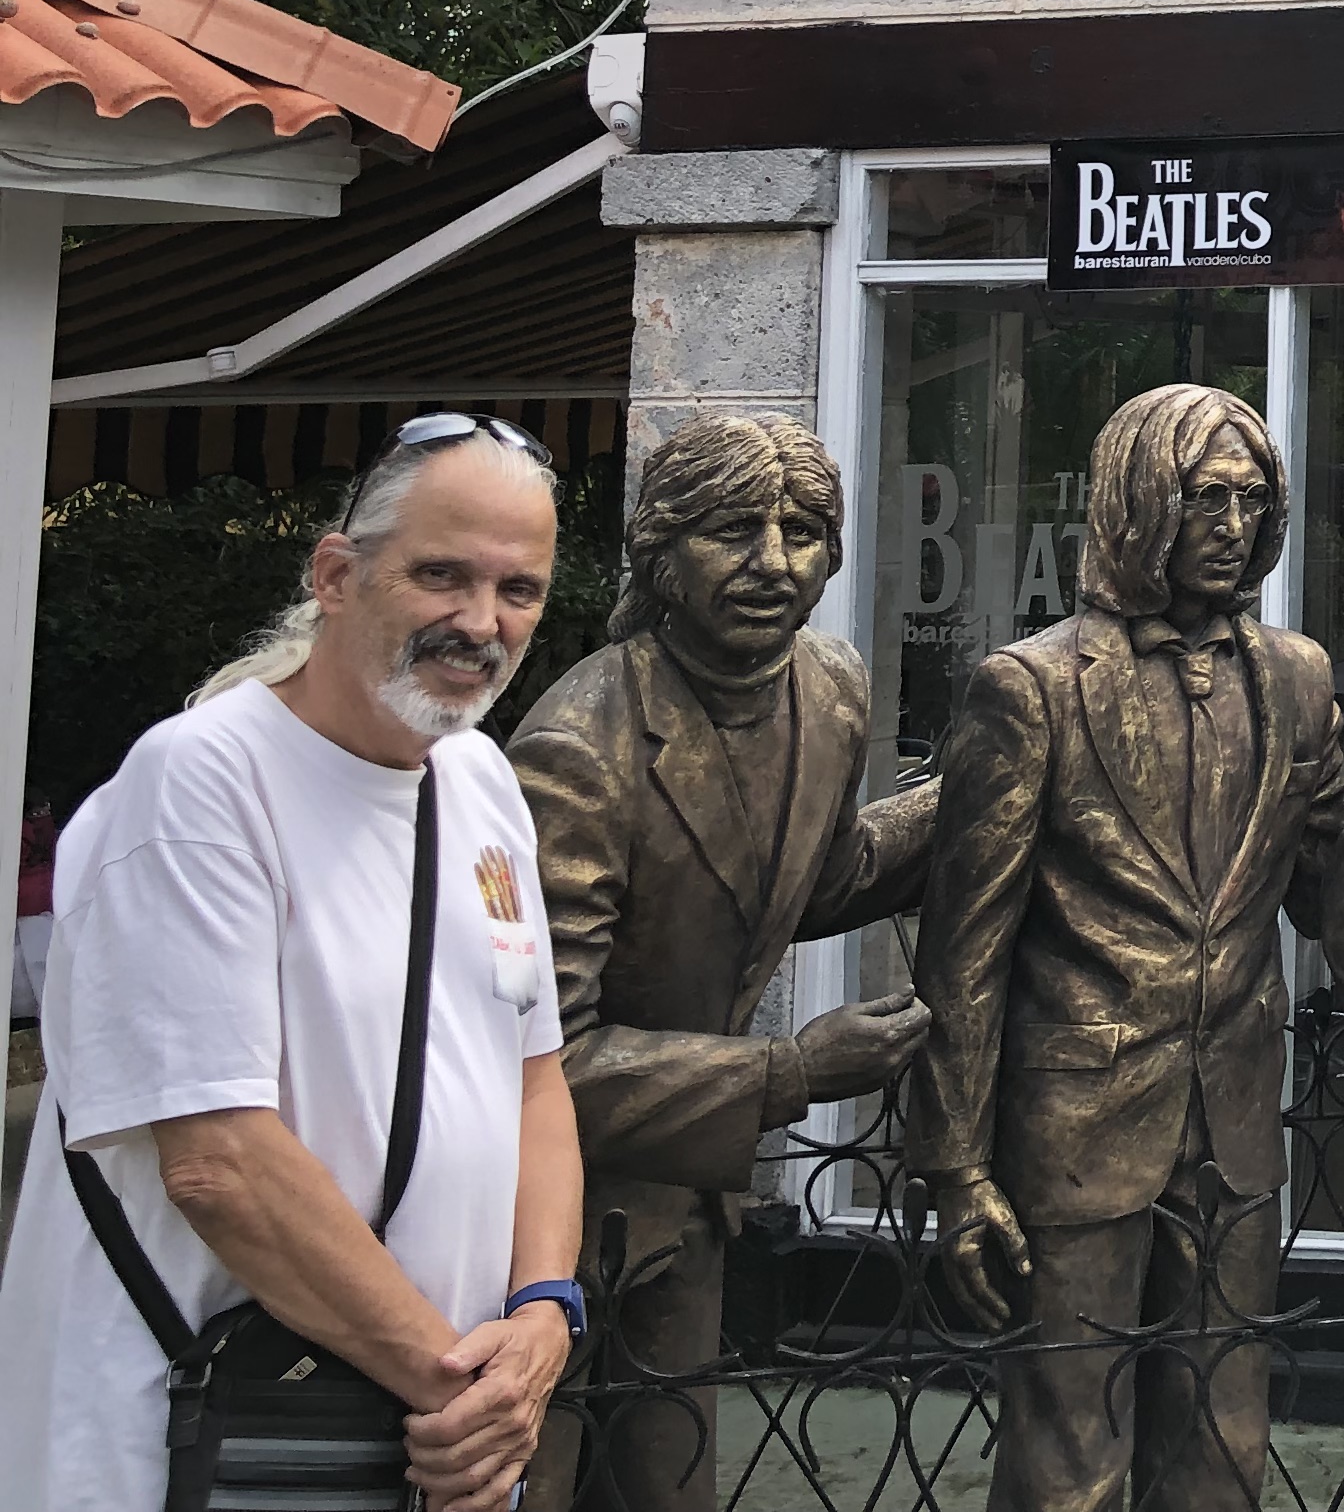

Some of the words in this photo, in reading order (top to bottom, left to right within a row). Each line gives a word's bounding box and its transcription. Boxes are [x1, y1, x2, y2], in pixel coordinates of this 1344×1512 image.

[1151, 159, 1193, 184] THE
[1075, 162, 1272, 267] BEATLES
[1074, 254, 1170, 269] barestauran
[1186, 254, 1272, 266] varadero/cuba
